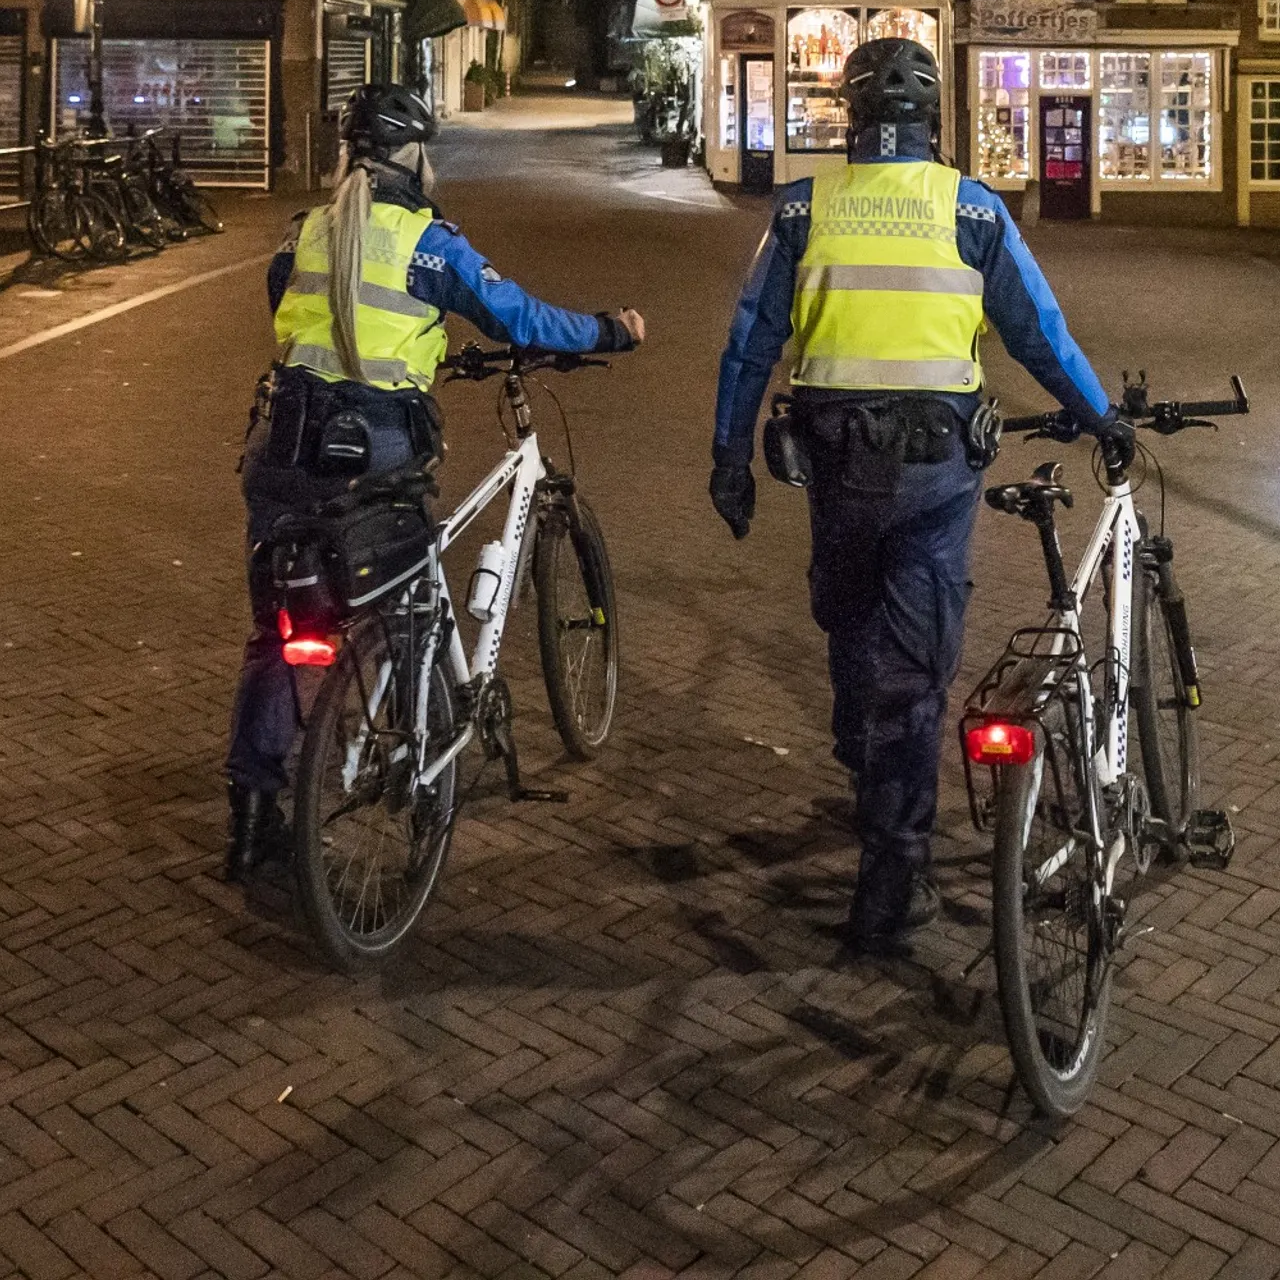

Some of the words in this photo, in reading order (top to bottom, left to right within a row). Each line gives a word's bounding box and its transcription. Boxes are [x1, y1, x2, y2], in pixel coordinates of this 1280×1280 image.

[980, 8, 1089, 33] Poffertjes
[825, 196, 935, 220] HANDHAVING
[500, 550, 519, 617] HANDHAVING
[1121, 603, 1130, 681] HNDHAVING
